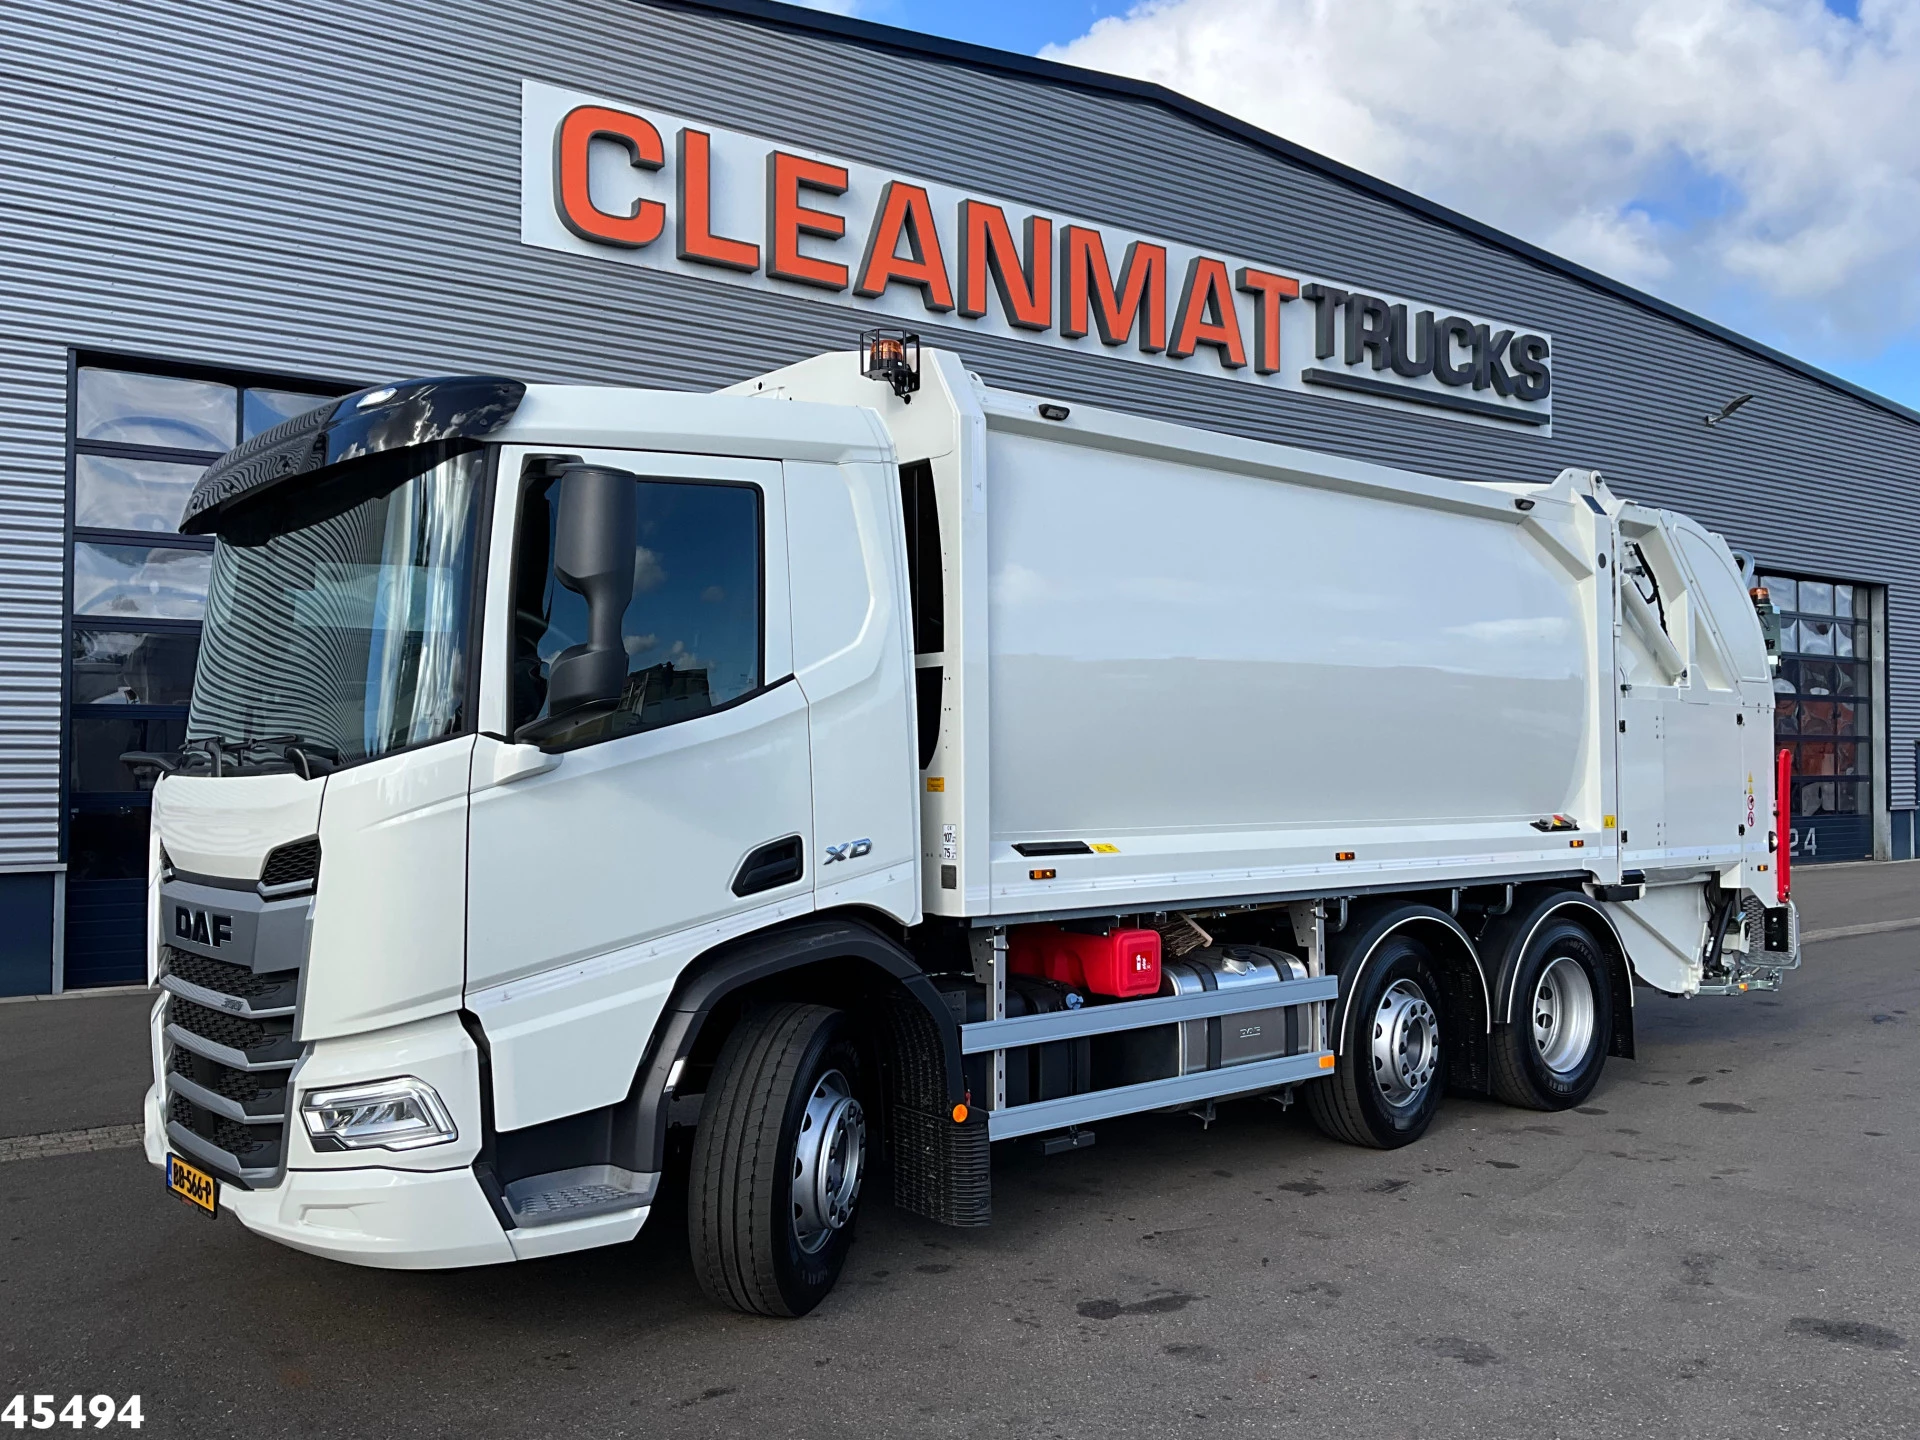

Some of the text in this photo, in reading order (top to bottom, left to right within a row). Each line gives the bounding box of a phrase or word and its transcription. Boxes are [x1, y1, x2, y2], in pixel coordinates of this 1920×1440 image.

[552, 104, 1550, 401] CLEANMAT TRUCKS
[823, 837, 872, 866] XD
[943, 847, 951, 858] 75
[1789, 827, 1817, 856] 24
[175, 905, 234, 949] DAF
